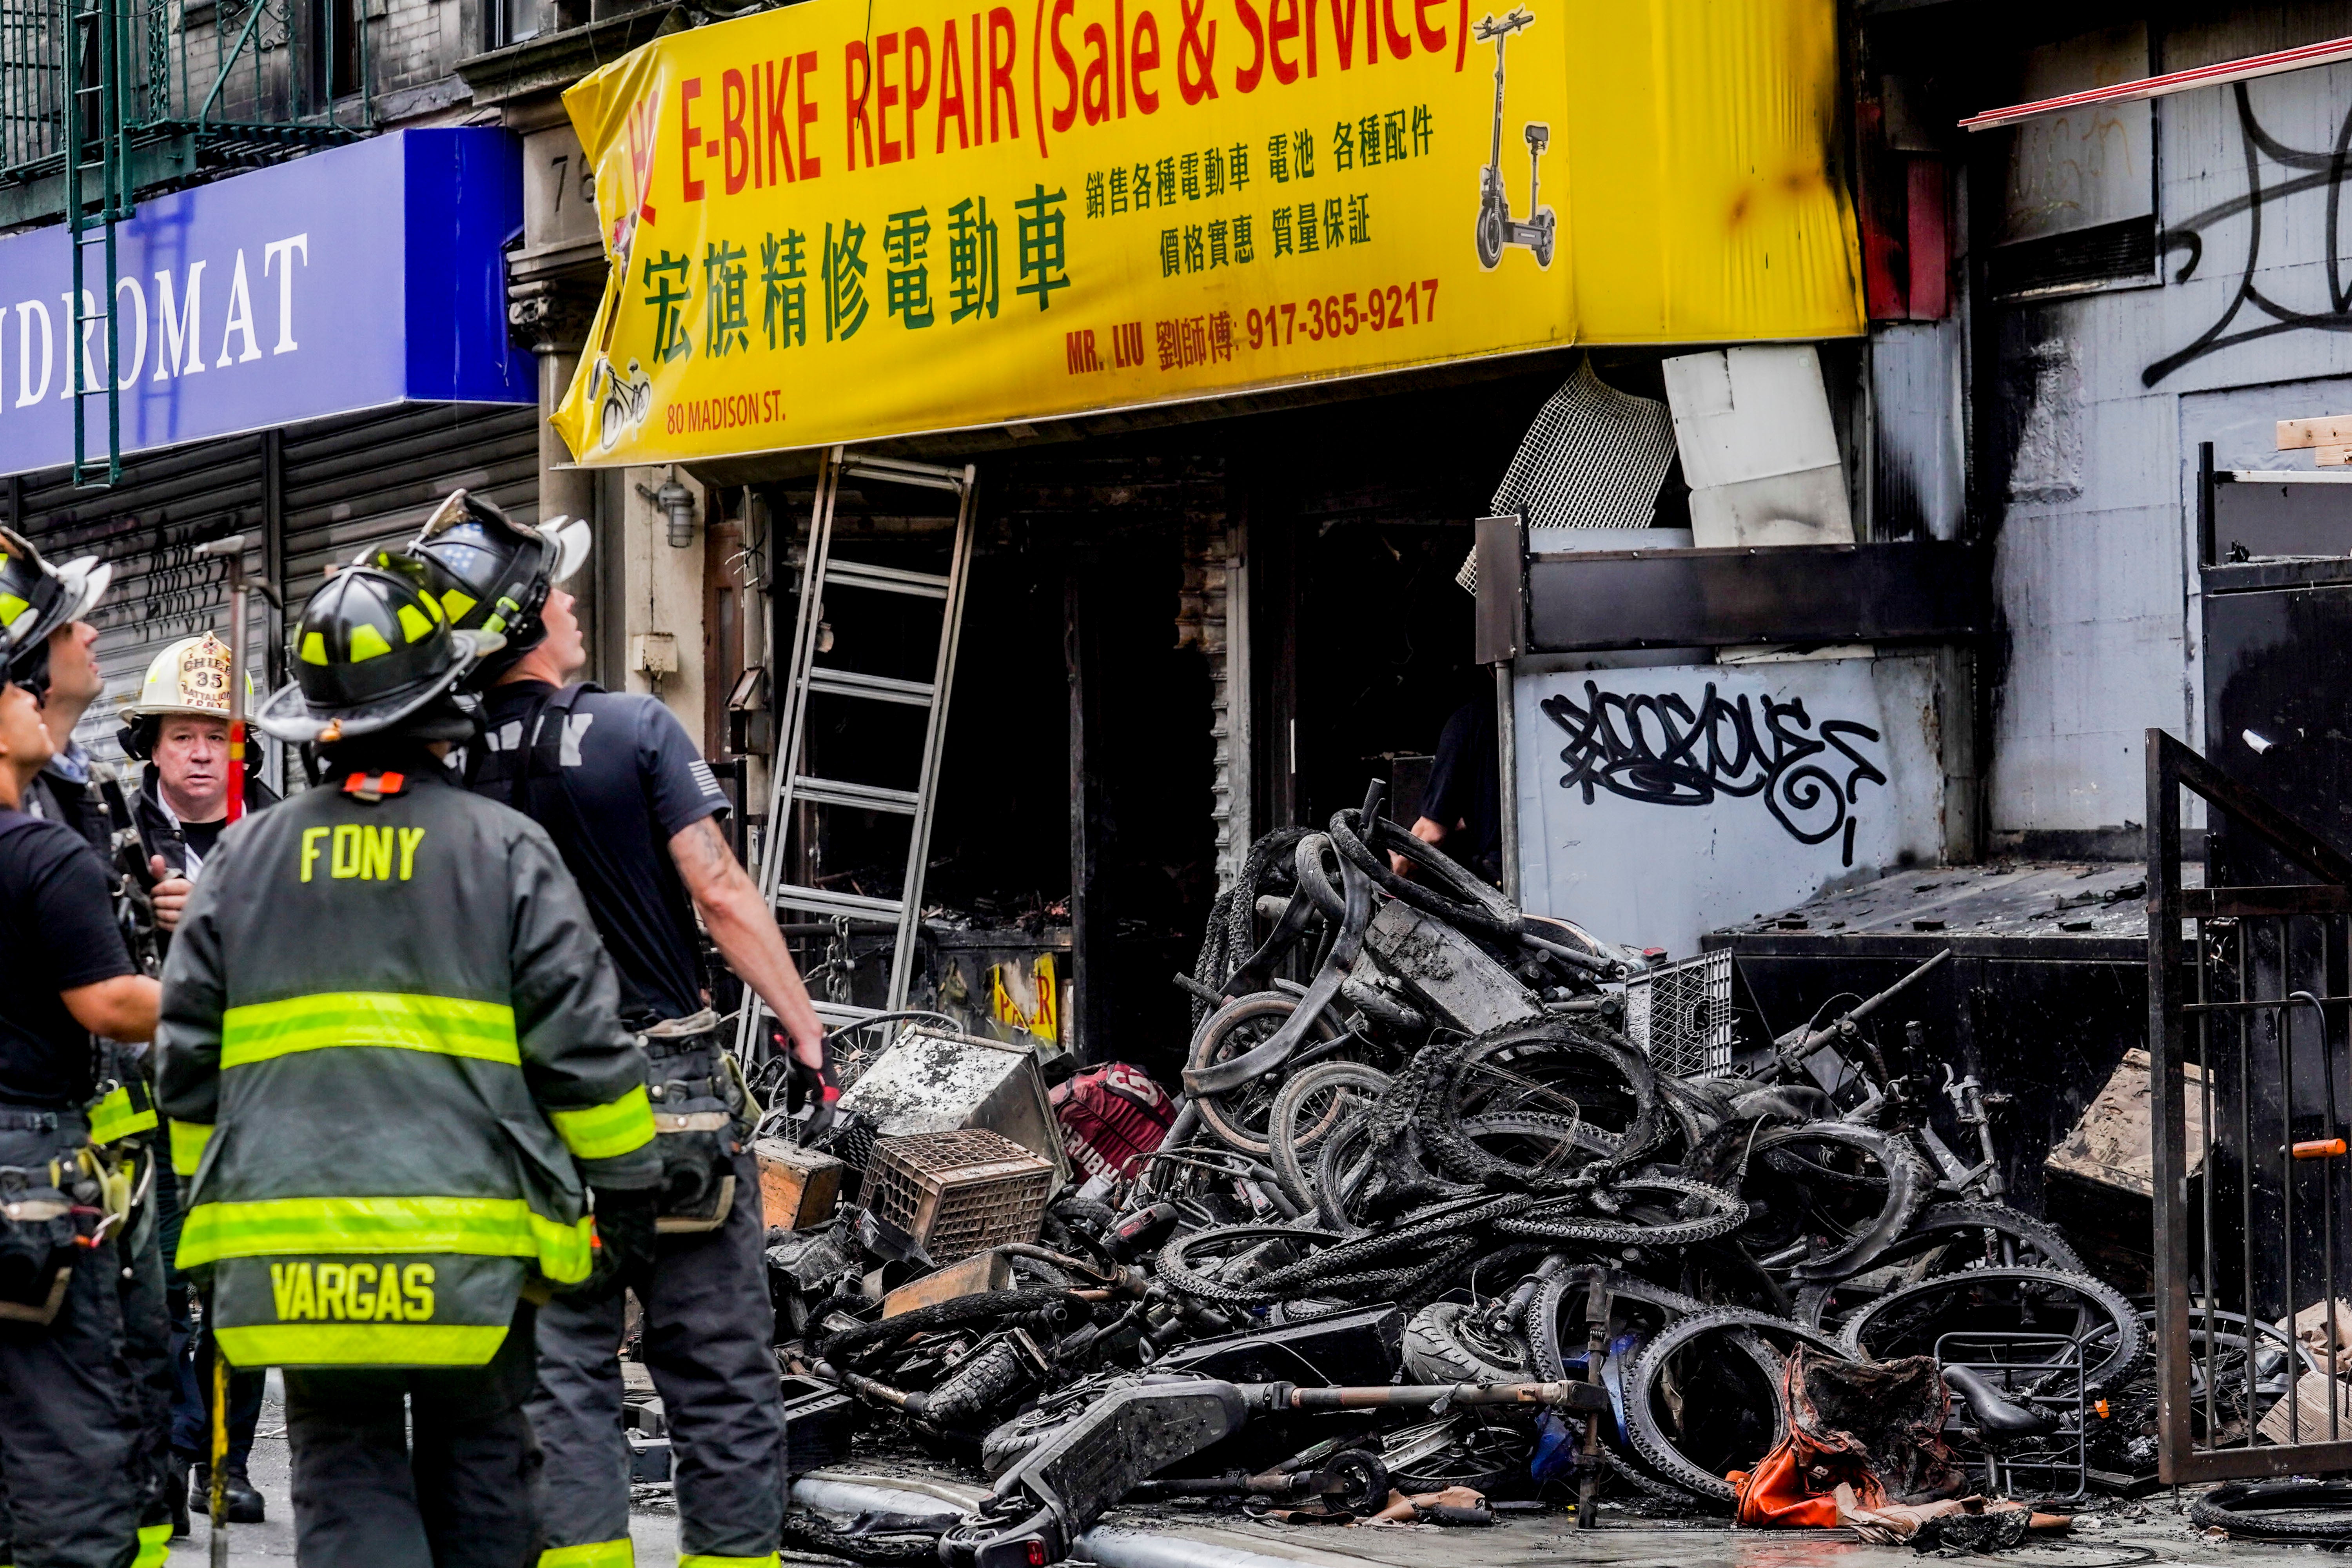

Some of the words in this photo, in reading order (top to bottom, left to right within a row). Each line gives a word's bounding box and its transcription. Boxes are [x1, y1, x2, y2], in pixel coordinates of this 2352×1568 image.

[681, 51, 821, 203] E-BIKE
[845, 6, 1020, 171] REPAIR
[1034, 0, 1160, 158] (Sale
[1177, 0, 1219, 105] &
[1085, 142, 1250, 220] 銷售各種電動車
[1267, 128, 1315, 183] 電池
[1333, 103, 1434, 173] 各種配件
[642, 183, 1071, 365] 宏旗精修電動車
[1160, 214, 1255, 278] 價格實惠
[0, 233, 308, 414] DROMAT
[1066, 329, 1104, 375] MR.
[1112, 321, 1144, 368] LIU
[1247, 279, 1439, 350] 917-365-9217
[668, 403, 684, 435] 80
[688, 392, 759, 433] MADISON
[764, 389, 786, 423] ST.
[196, 671, 223, 689] 35
[301, 824, 425, 882] FDNY
[271, 1262, 436, 1321] VARGAS
